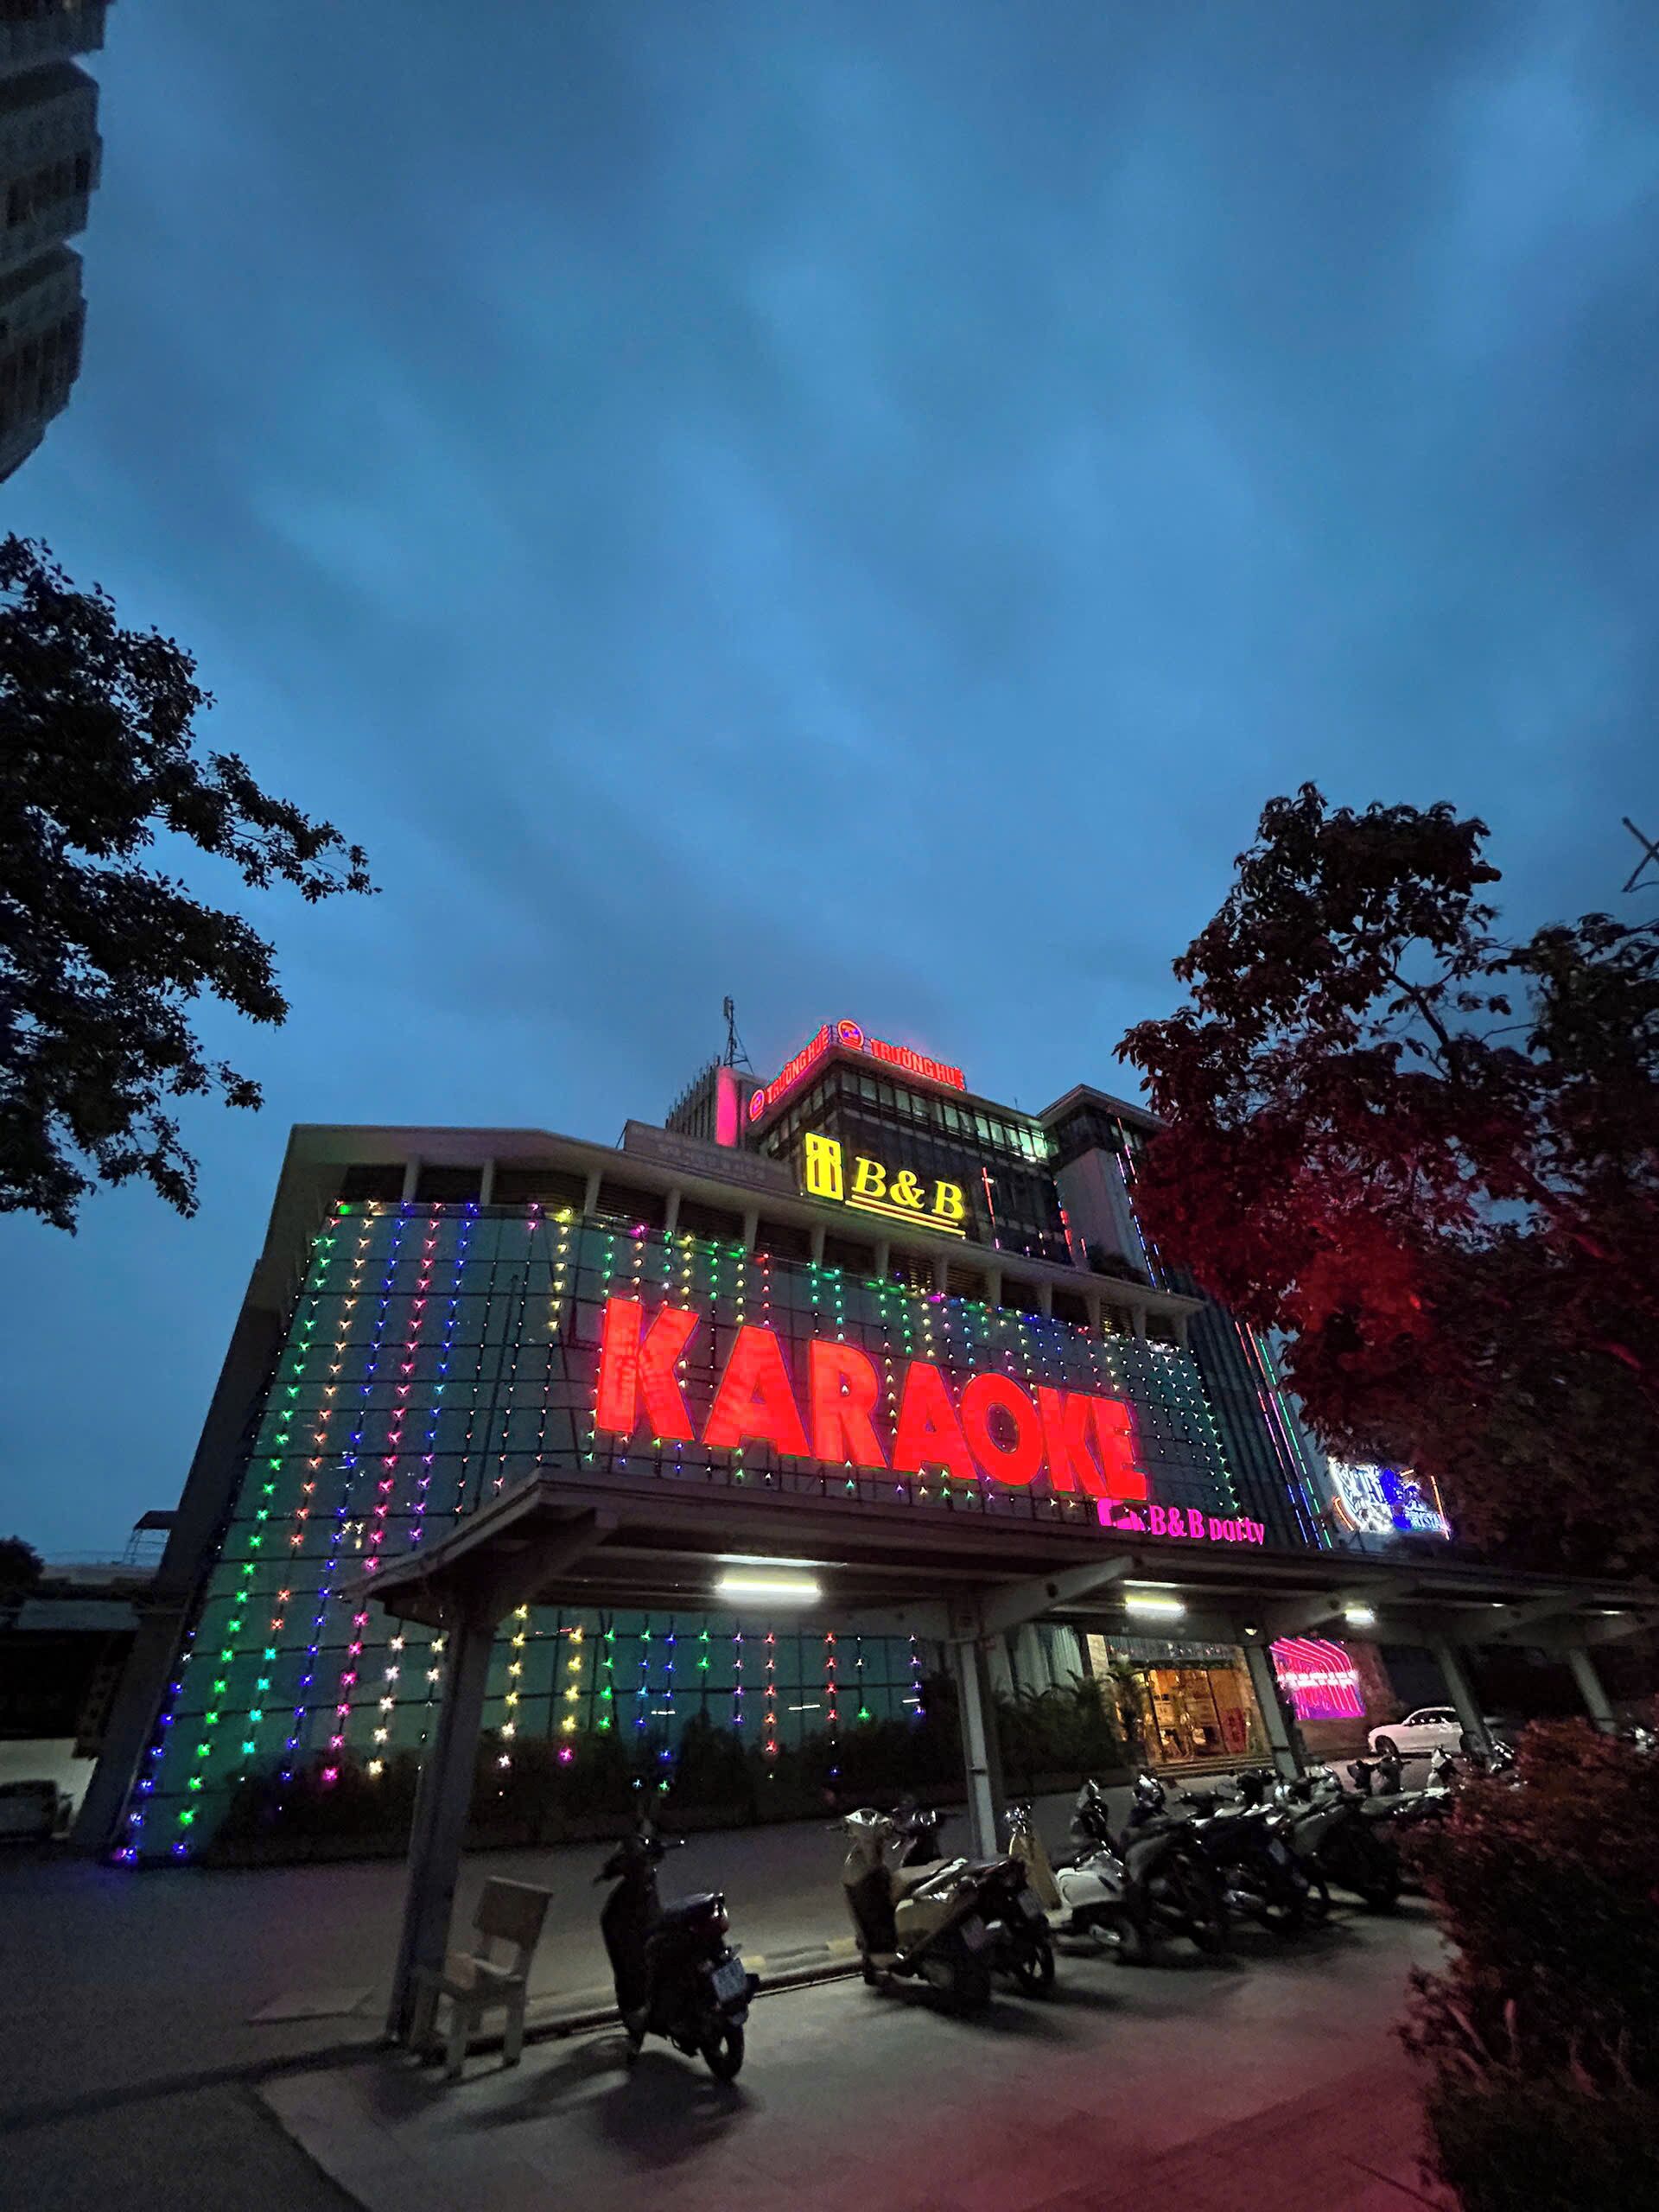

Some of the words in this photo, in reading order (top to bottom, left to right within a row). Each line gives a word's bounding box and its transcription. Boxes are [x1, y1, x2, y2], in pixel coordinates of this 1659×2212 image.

[850, 1156, 964, 1220] B&B
[597, 1296, 1147, 1501] KARAOKE
[1148, 1504, 1205, 1539] B&B
